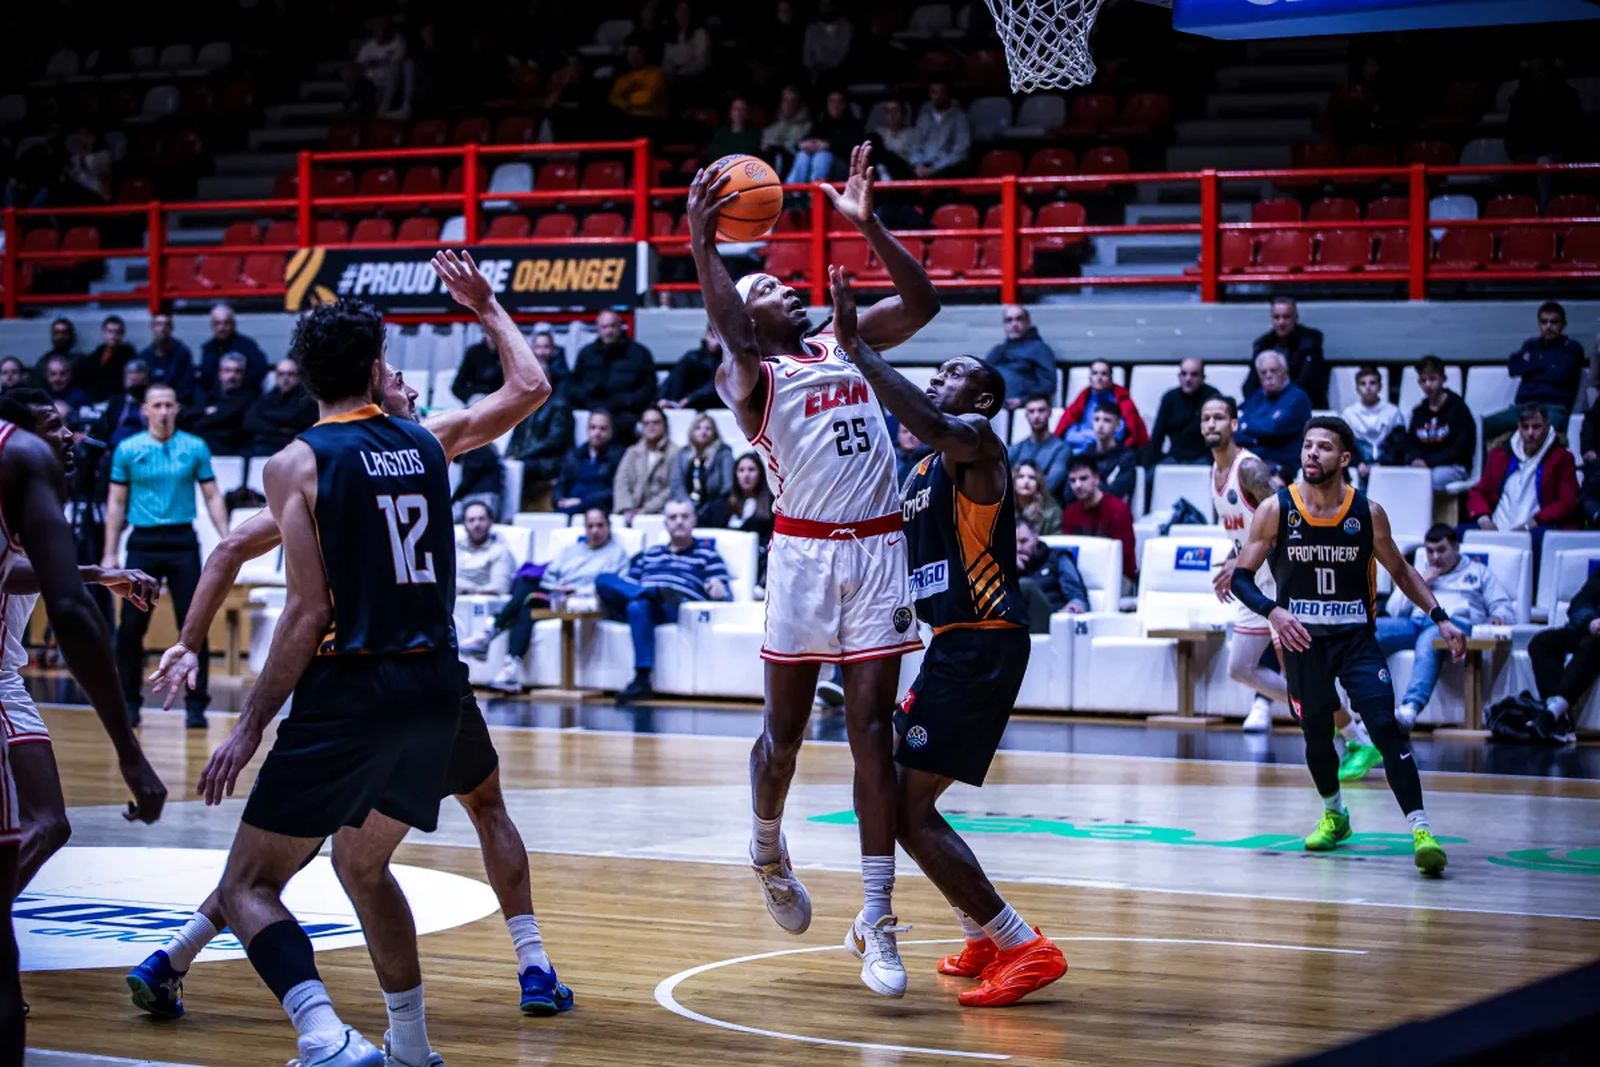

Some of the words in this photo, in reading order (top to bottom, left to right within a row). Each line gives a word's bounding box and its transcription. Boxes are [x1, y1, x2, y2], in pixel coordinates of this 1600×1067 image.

[338, 260, 438, 295] #PROUD
[512, 259, 625, 291] ORANGE!
[804, 376, 869, 419] ELAN
[832, 417, 871, 457] 25
[360, 449, 425, 476] LAGIOS
[376, 494, 437, 584] 12
[1314, 566, 1336, 595] 10
[1290, 602, 1320, 617] MED
